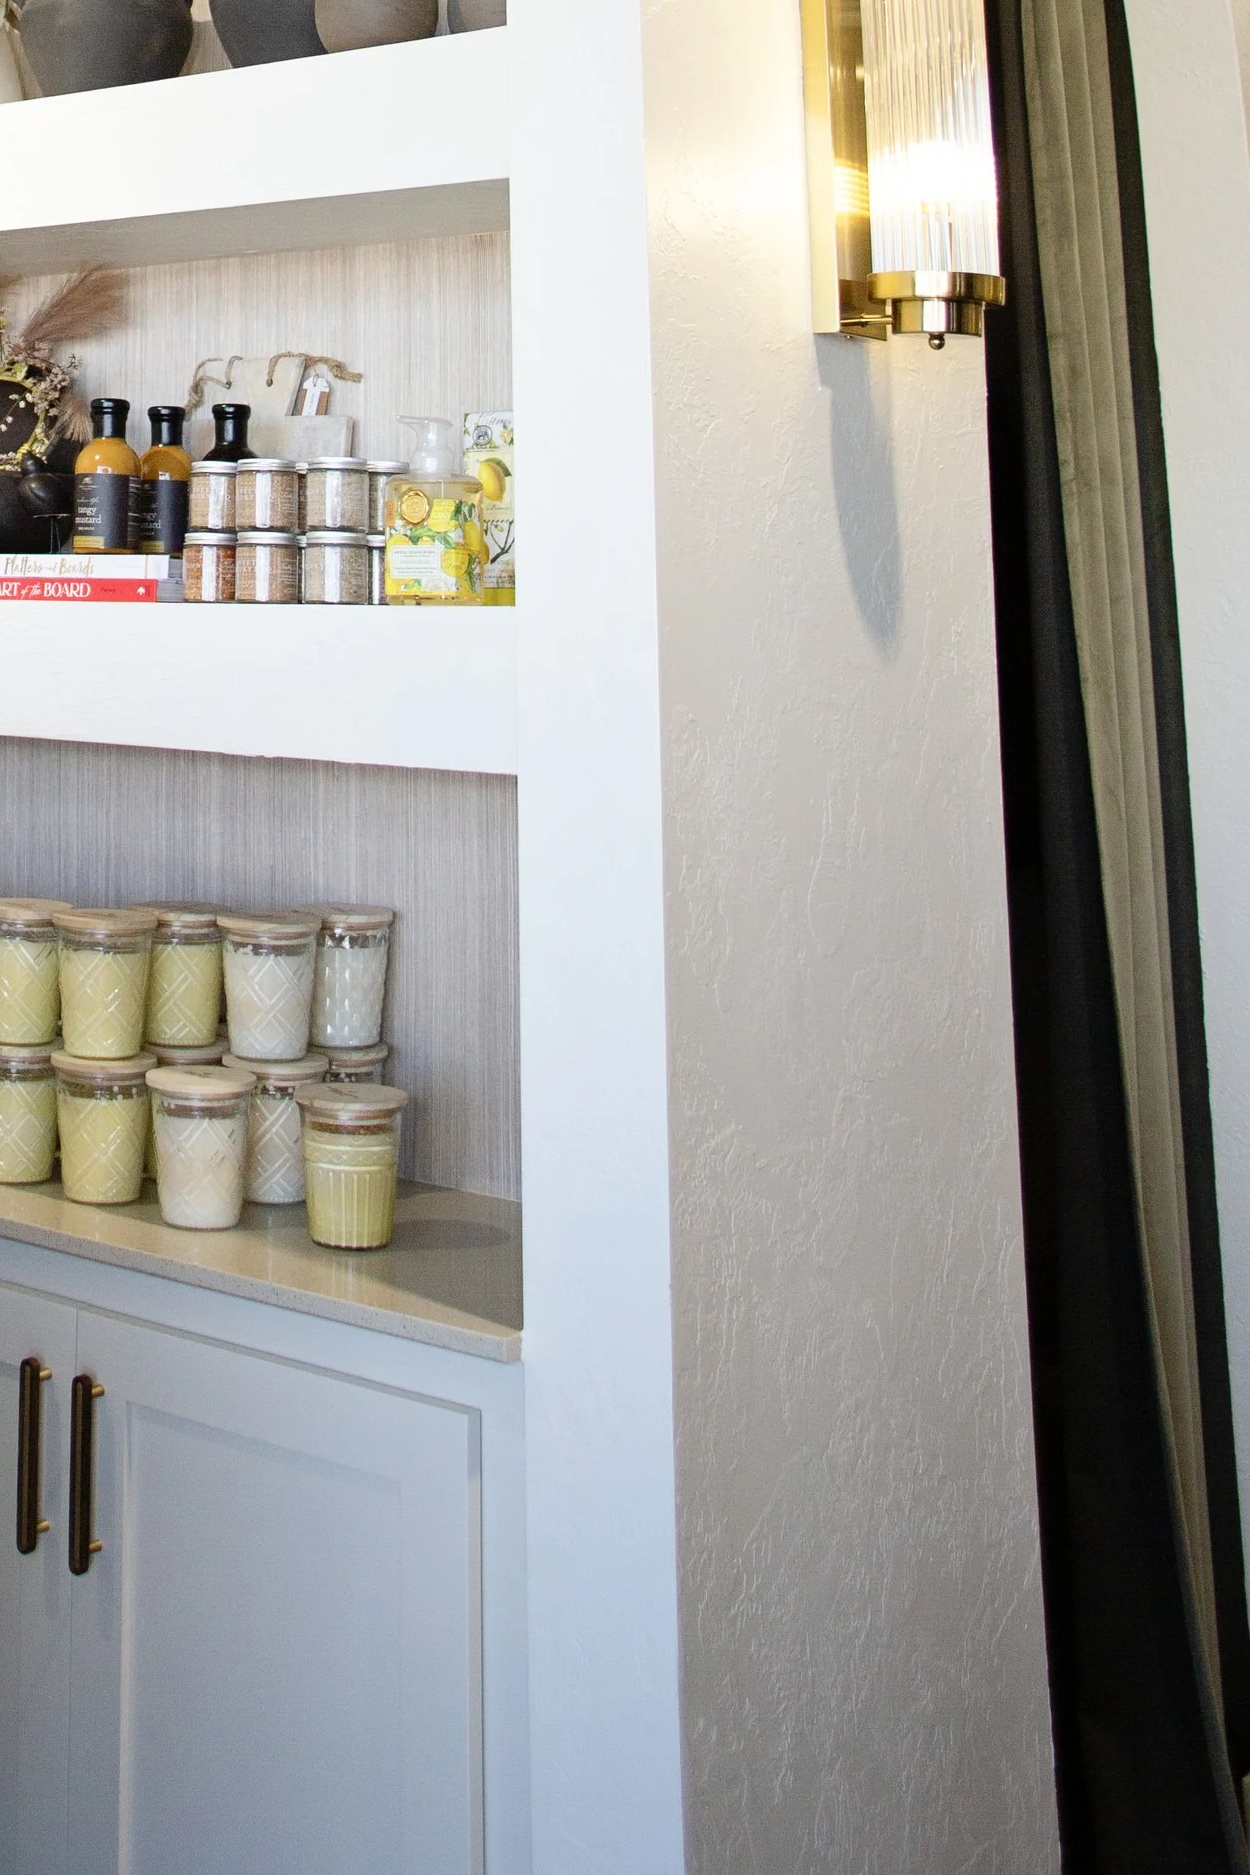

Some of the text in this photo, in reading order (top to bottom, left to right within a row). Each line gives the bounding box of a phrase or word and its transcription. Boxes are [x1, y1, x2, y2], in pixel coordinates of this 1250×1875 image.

[3, 556, 44, 575] Platters
[59, 557, 95, 575] Boards
[20, 584, 29, 599] of
[29, 581, 43, 598] the
[43, 582, 91, 598] BOARD
